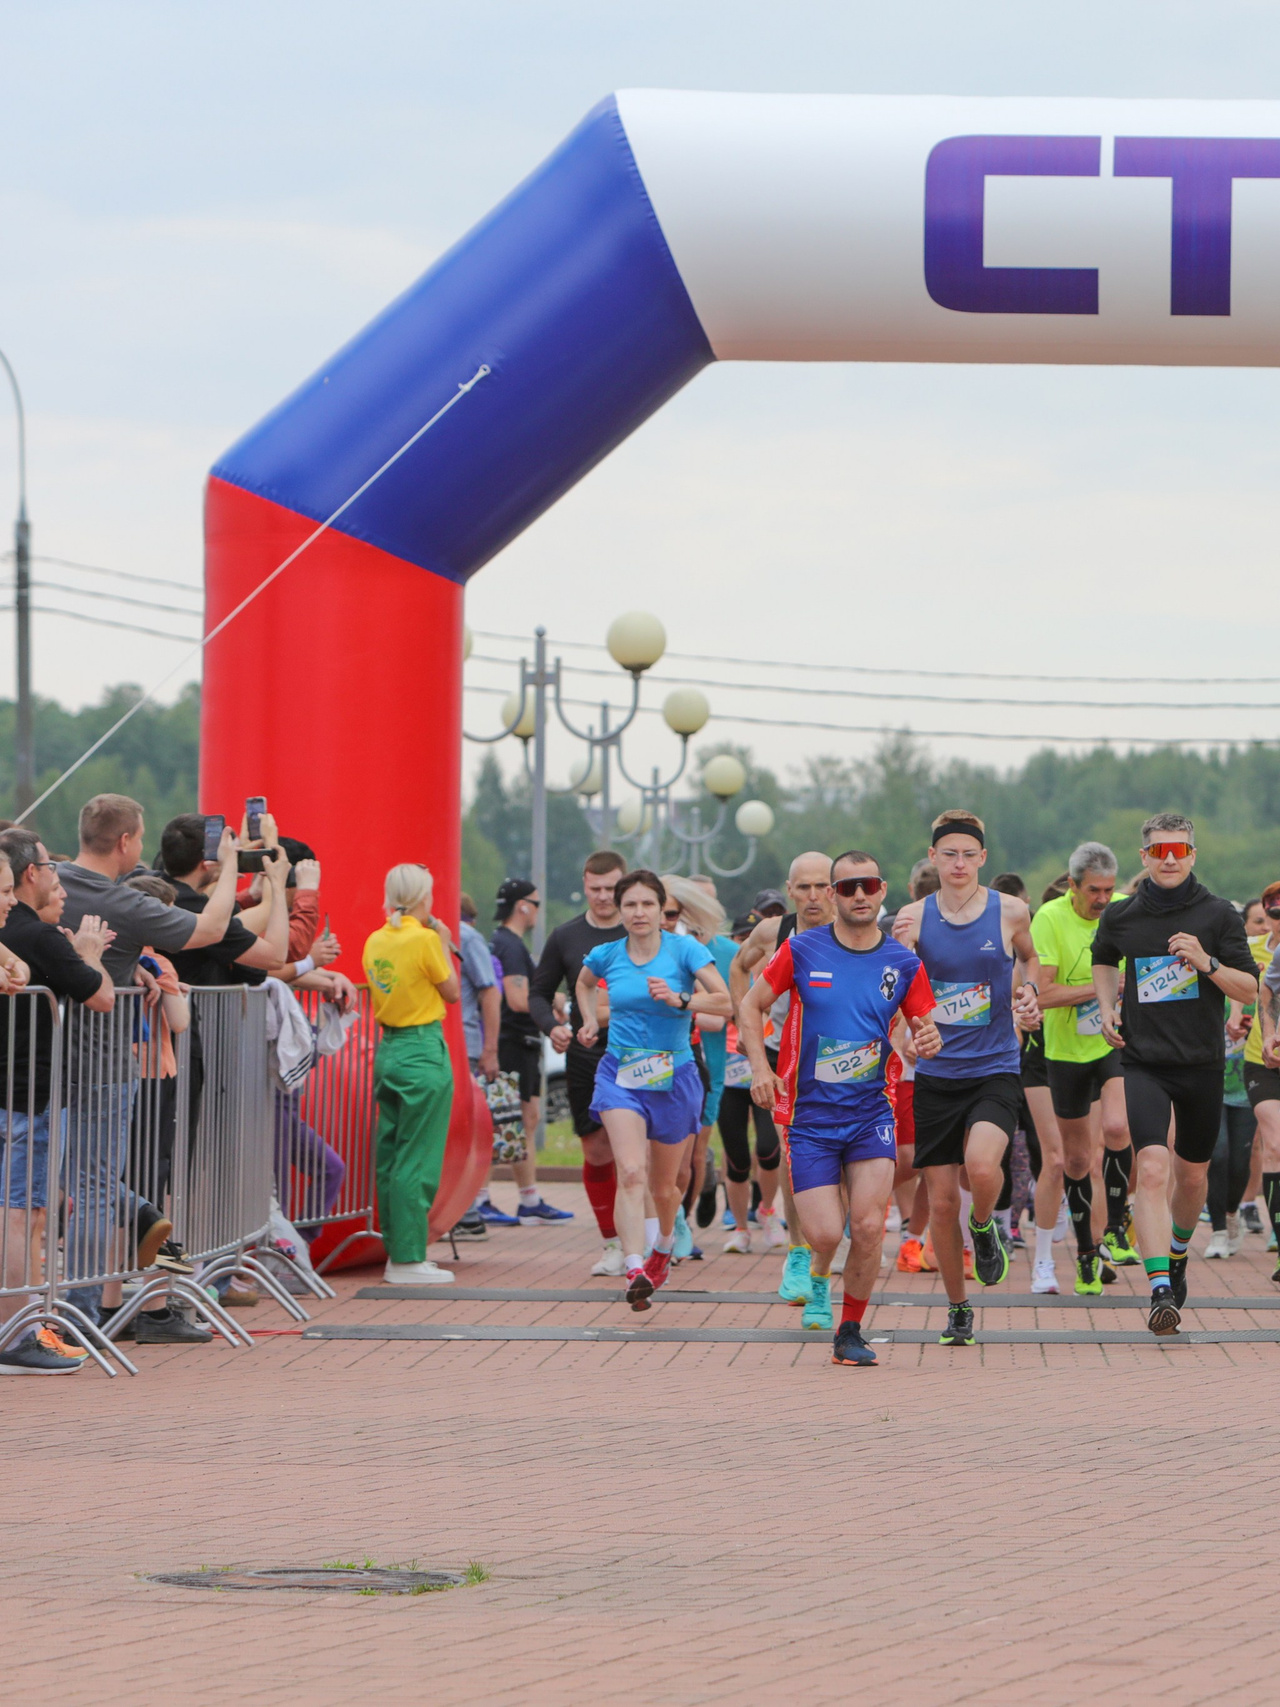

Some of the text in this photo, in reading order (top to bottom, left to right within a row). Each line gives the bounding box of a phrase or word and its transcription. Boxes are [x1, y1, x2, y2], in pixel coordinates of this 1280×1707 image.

[1150, 970, 1178, 993] 124
[943, 997, 971, 1016] 174
[633, 1063, 654, 1078] 44
[832, 1056, 863, 1075] 122
